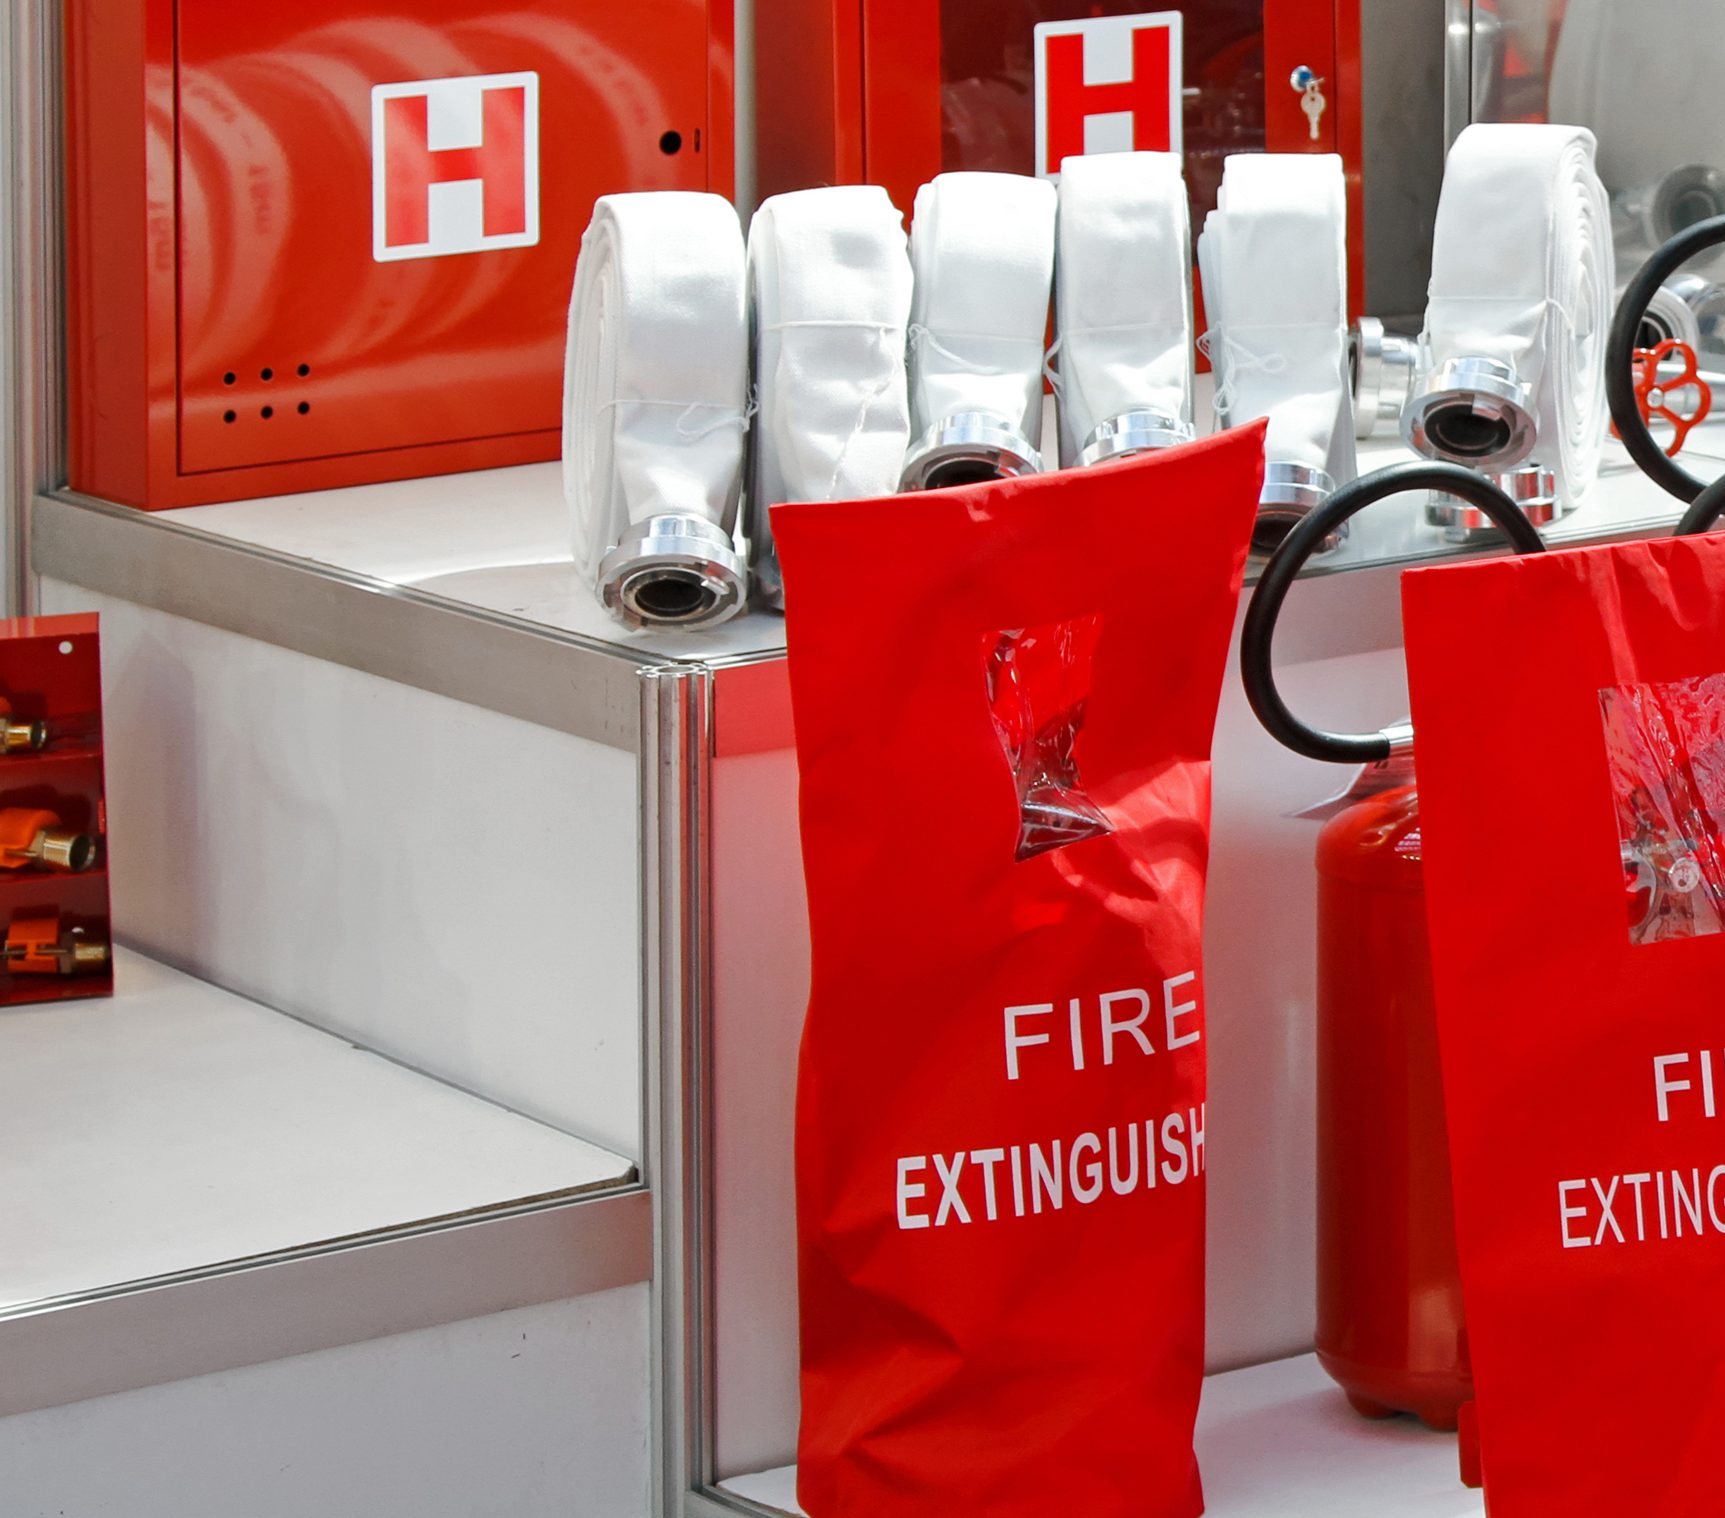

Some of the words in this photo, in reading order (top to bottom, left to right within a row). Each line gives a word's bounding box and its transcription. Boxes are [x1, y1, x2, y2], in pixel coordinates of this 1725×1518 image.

[384, 86, 527, 247] H
[1046, 25, 1171, 174] H
[1004, 970, 1200, 1080] FIRE
